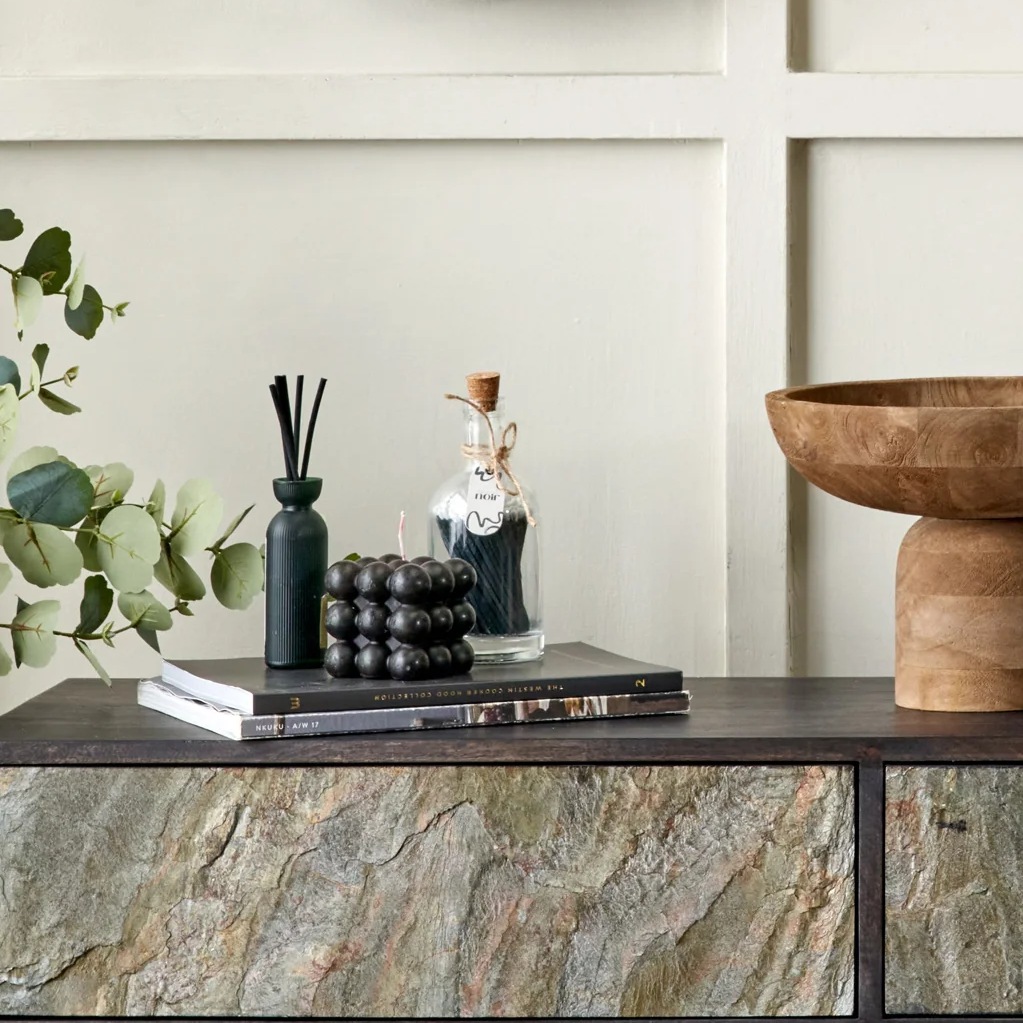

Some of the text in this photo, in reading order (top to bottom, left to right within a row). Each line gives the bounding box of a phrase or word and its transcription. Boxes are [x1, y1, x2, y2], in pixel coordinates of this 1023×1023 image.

[474, 493, 500, 501] noir
[374, 692, 432, 701] COLLECTION
[255, 723, 284, 732] NKUKU
[292, 722, 309, 730] A/W
[311, 721, 320, 729] 17
